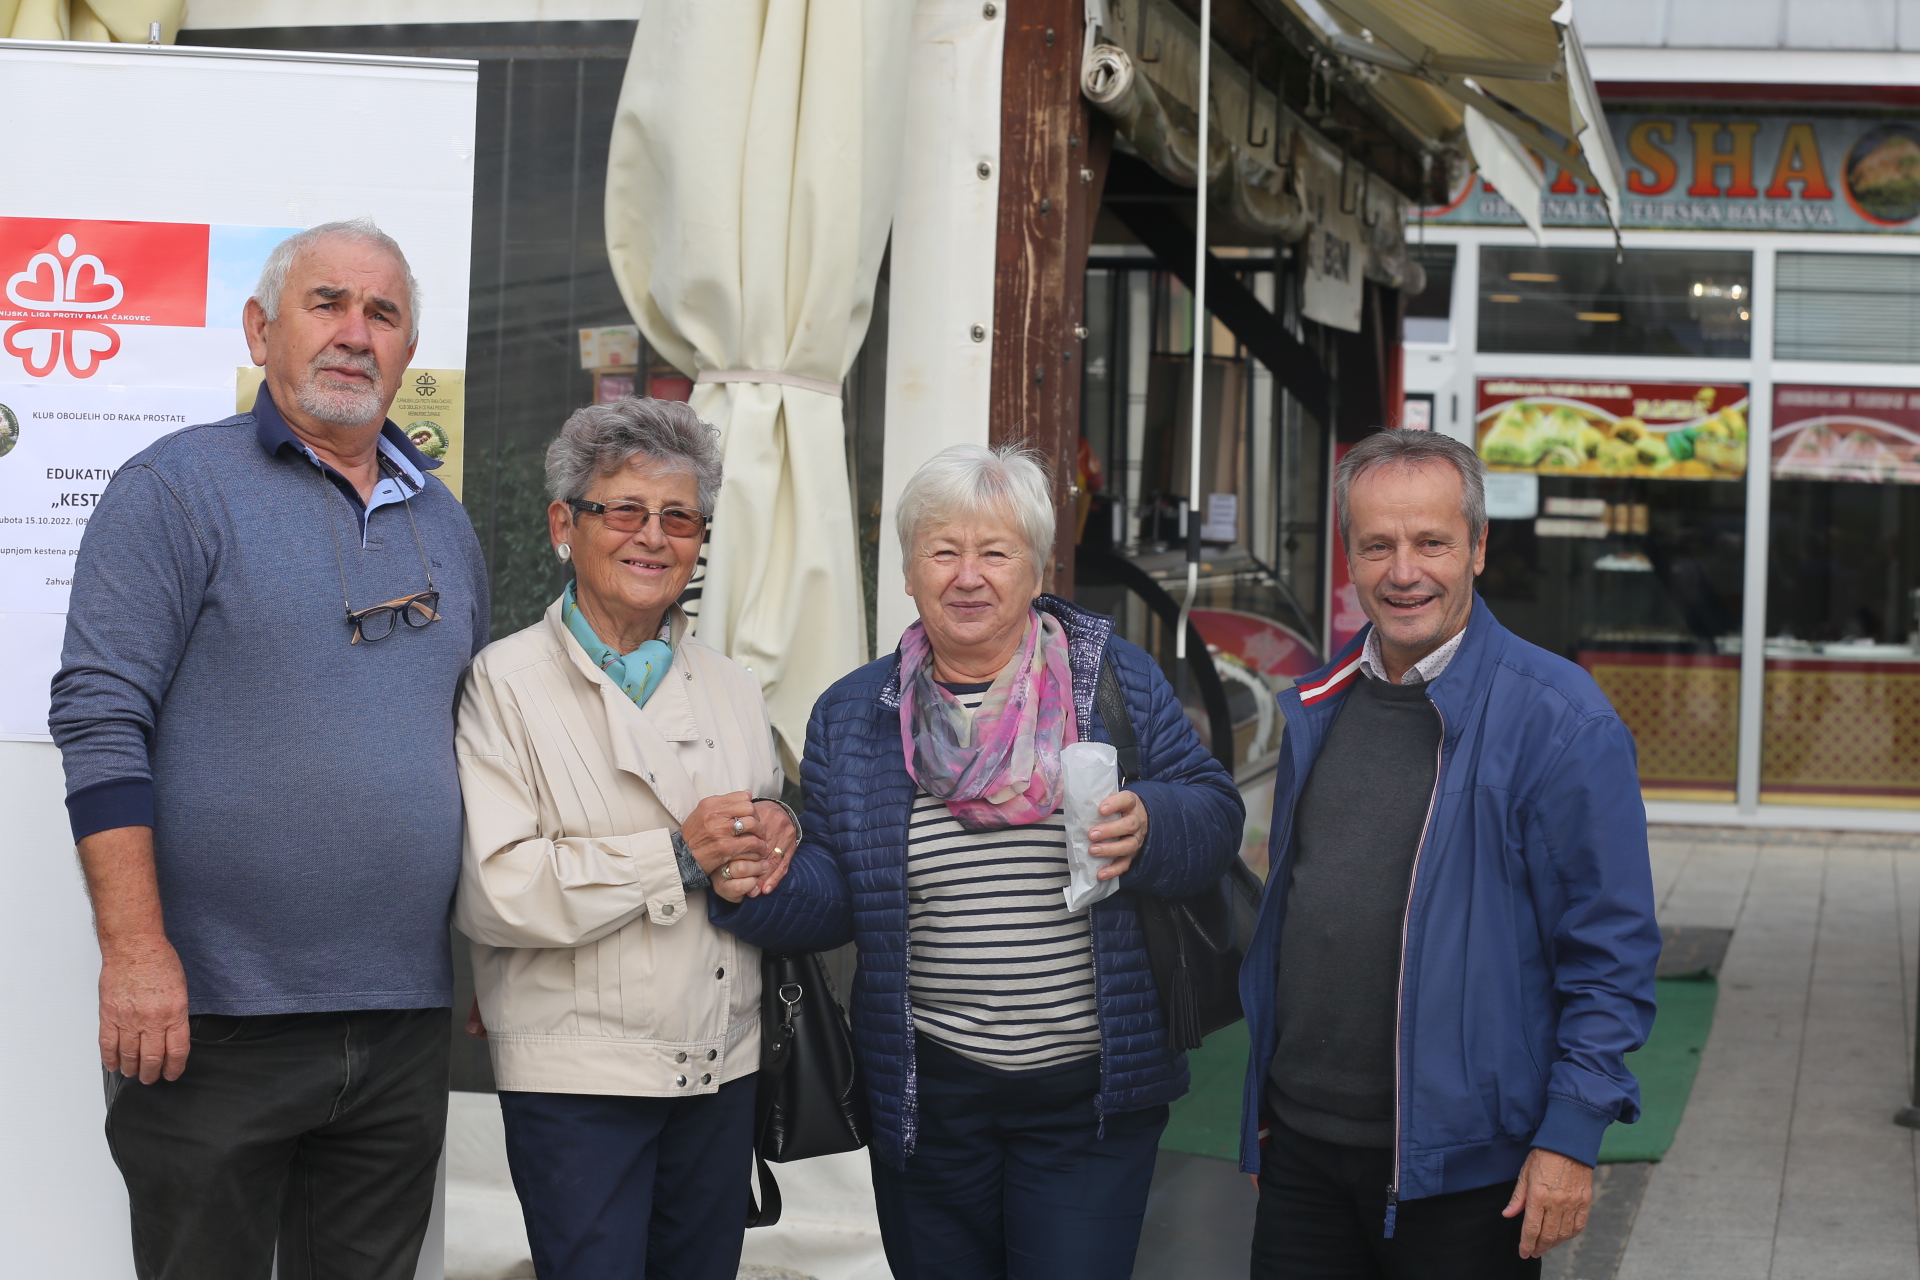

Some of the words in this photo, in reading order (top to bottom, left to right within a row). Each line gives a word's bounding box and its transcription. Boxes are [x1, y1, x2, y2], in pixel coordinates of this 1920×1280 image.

[1631, 203, 1725, 223] TURSKA
[1728, 204, 1834, 225] BAKLAVA
[111, 313, 151, 322] ČAKOVEC
[32, 411, 54, 420] KLUB
[57, 412, 100, 421] OBOLJELIH
[103, 412, 116, 421] OD
[118, 413, 141, 422] RAKA
[143, 414, 186, 423] PROSTATE
[25, 516, 73, 525] 15.10.2022.
[0, 547, 32, 556] upnjom
[34, 547, 66, 555] kestena
